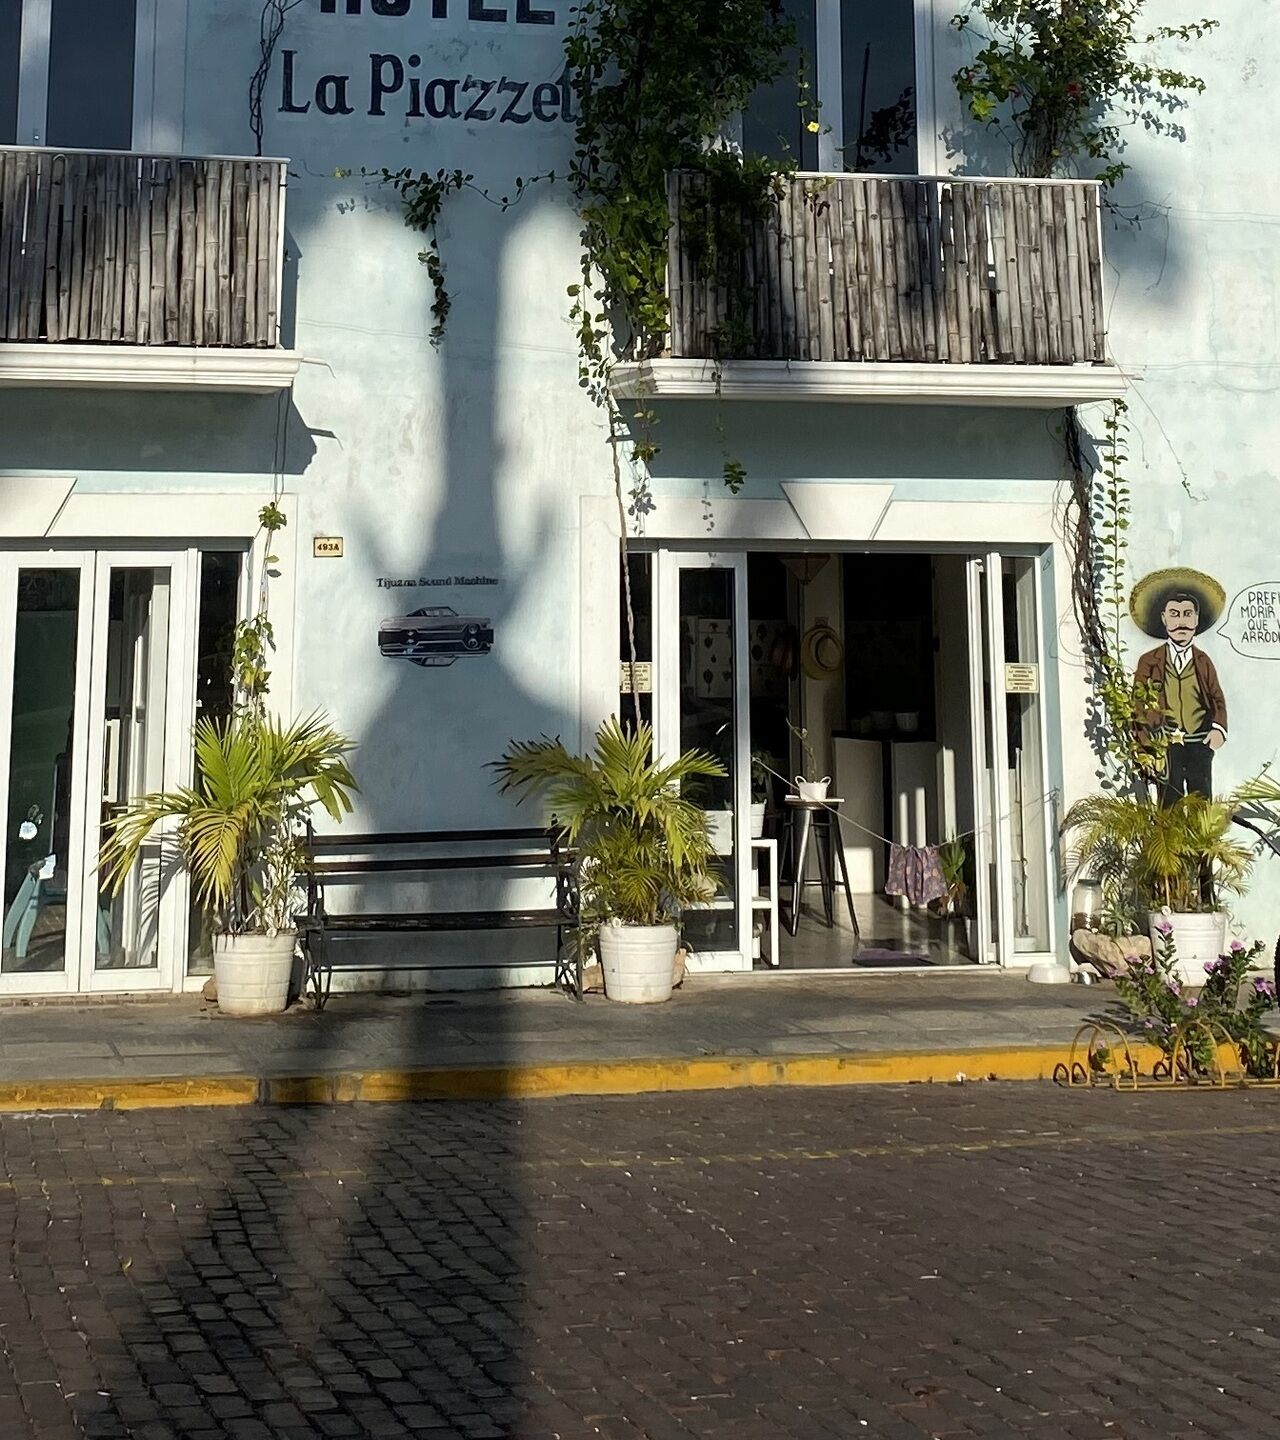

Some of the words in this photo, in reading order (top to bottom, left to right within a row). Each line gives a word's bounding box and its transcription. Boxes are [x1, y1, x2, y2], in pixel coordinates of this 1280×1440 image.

[278, 50, 354, 115] La
[368, 53, 580, 124] Piazzet
[1241, 605, 1276, 618] MORIR
[1248, 619, 1268, 631] QUE
